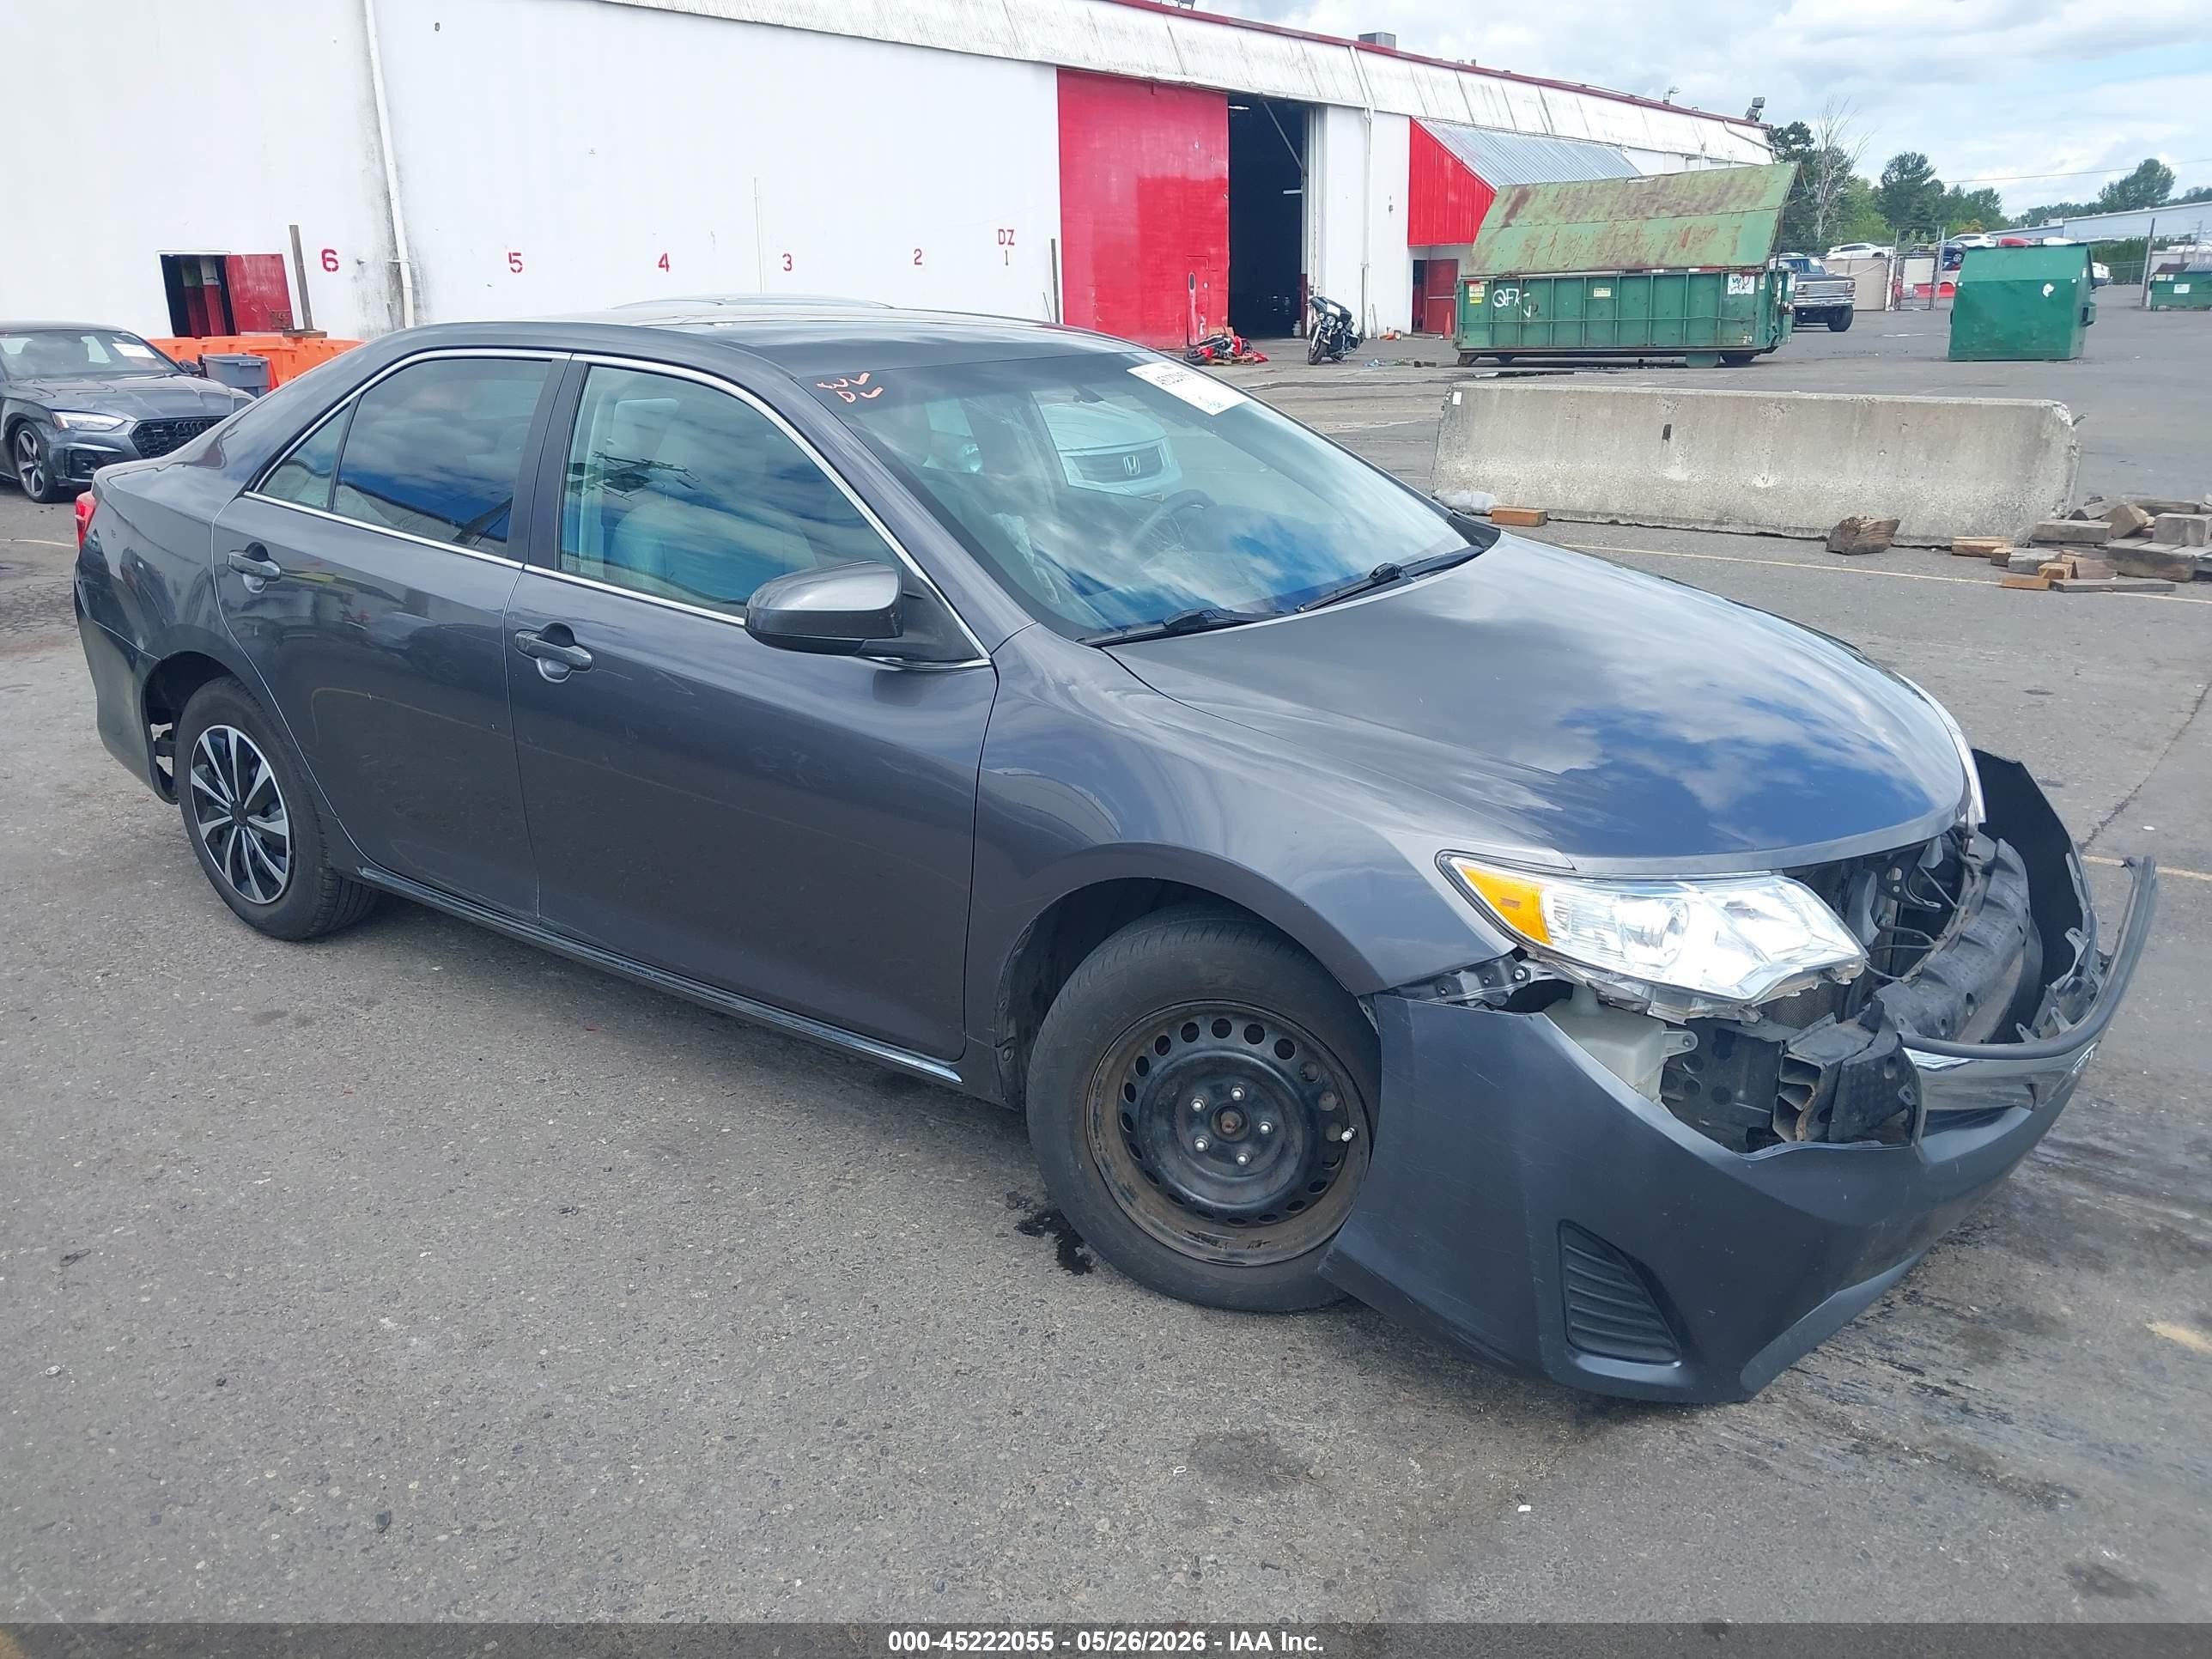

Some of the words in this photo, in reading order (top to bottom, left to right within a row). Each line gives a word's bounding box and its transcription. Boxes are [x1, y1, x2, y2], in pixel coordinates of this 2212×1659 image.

[998, 228, 1015, 246] DZ
[320, 248, 340, 273] 6
[507, 252, 523, 274] 5
[658, 252, 671, 273] 4
[782, 253, 793, 272] 3
[914, 248, 923, 266] 2
